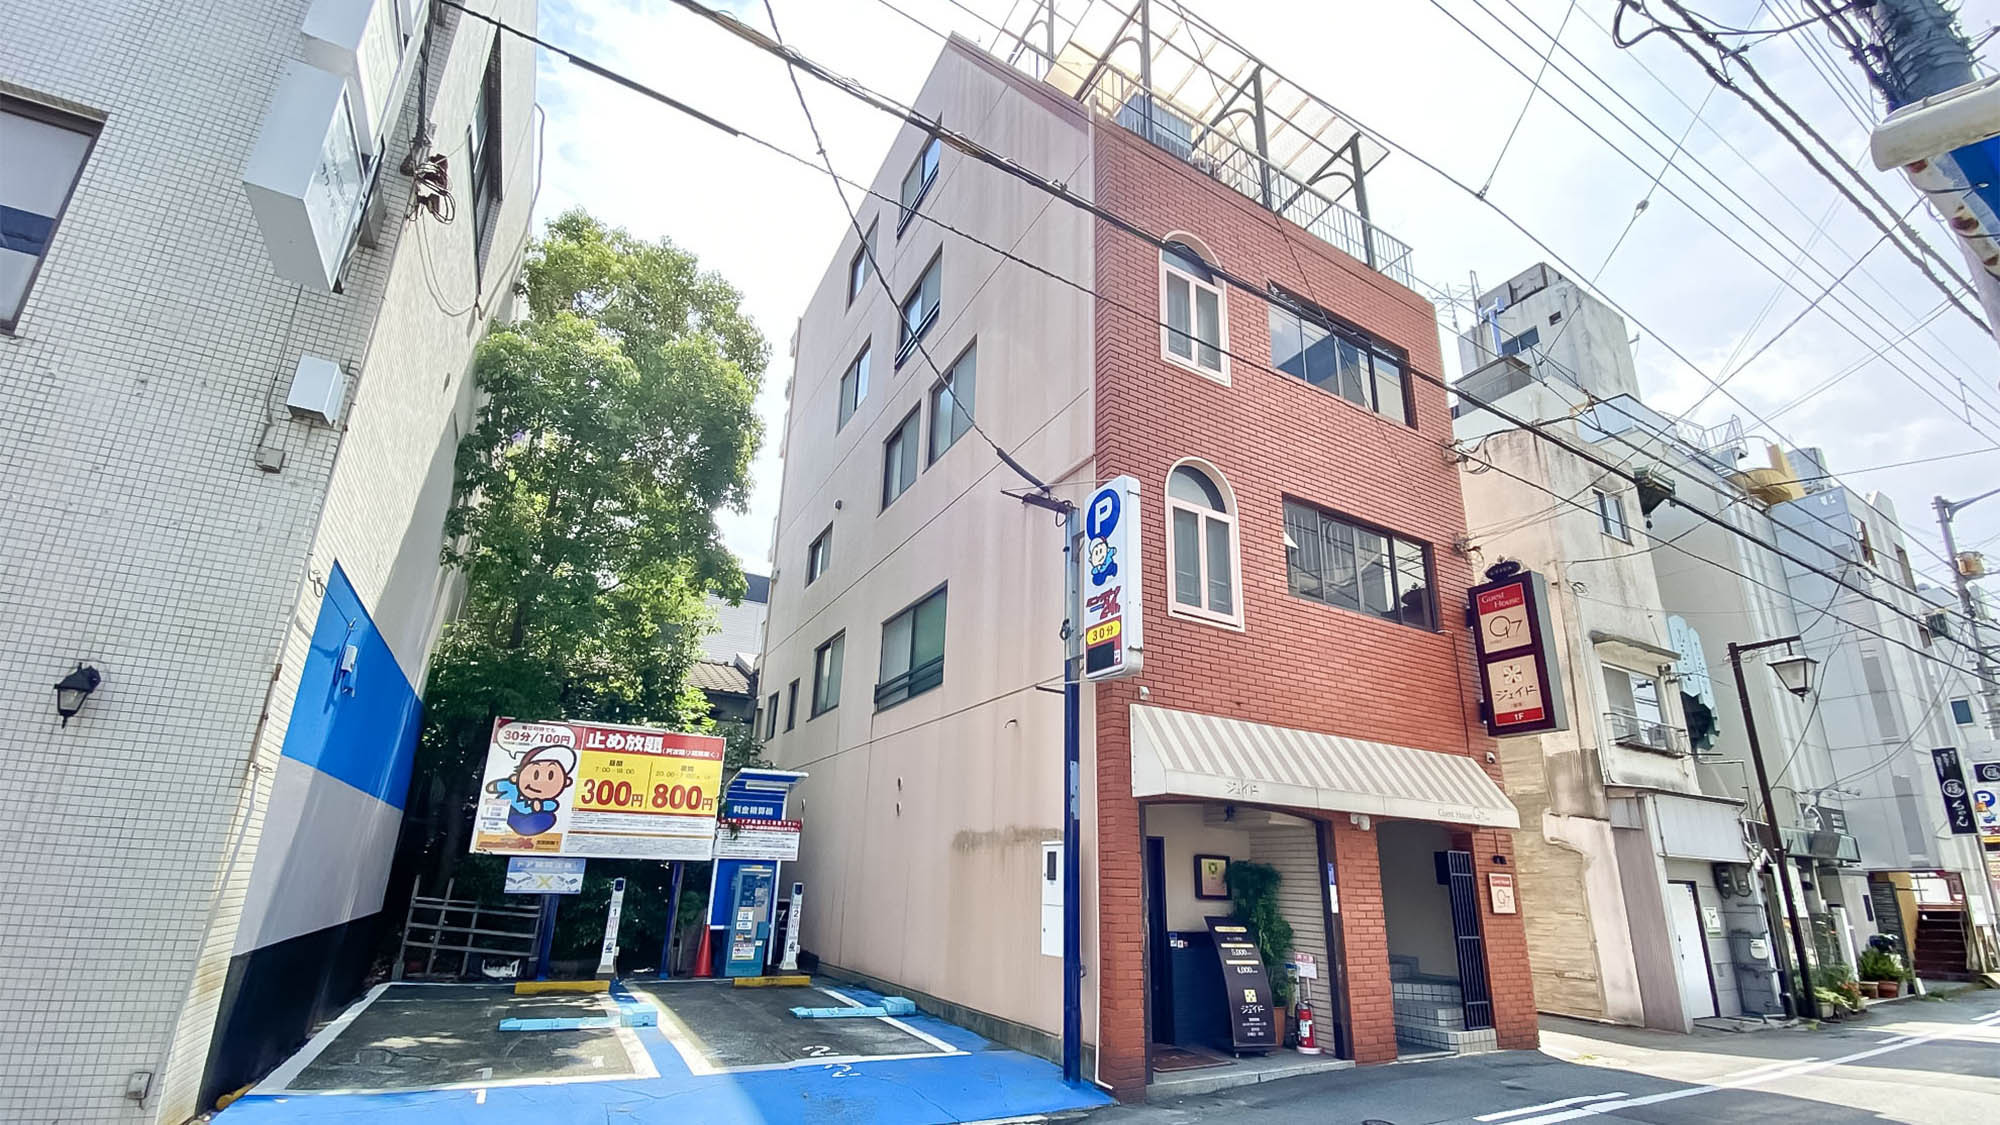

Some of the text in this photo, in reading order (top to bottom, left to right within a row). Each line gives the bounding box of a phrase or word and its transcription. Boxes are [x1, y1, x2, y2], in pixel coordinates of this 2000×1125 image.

[1095, 496, 1113, 535] P
[1481, 592, 1504, 604] Guest
[1493, 596, 1521, 609] House
[1092, 625, 1114, 642] 30分
[1489, 615, 1523, 638] Q7
[1495, 685, 1537, 703] ジェイド
[1513, 711, 1525, 721] 1F
[503, 730, 571, 745] 30分/100円
[585, 730, 664, 754] 止め放題
[581, 778, 644, 808] 300円
[651, 783, 714, 811] 800円
[612, 908, 617, 917] 1
[793, 910, 800, 918] 2
